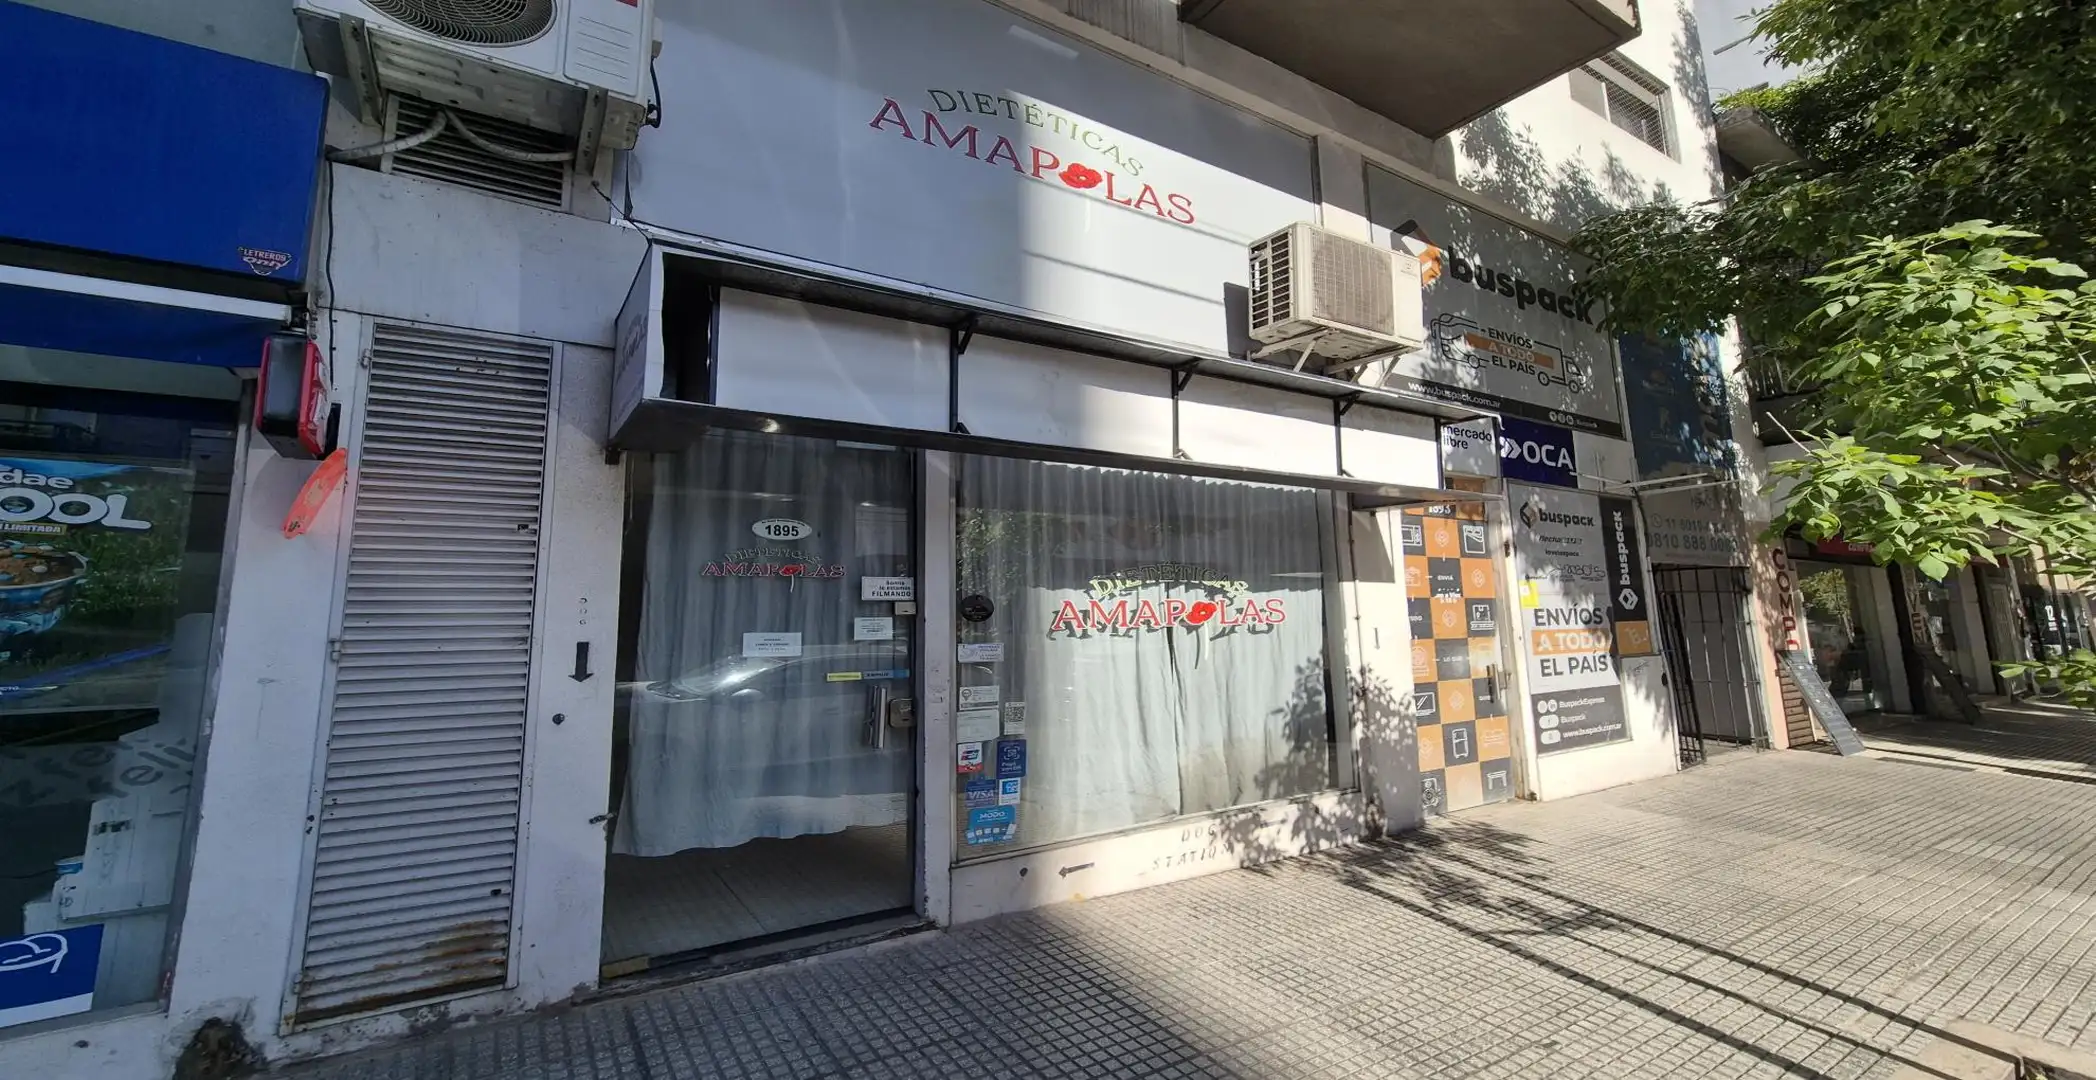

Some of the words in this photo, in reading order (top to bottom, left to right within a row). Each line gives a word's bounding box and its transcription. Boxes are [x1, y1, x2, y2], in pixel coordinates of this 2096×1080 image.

[927, 87, 1144, 177] DIETÉTICAS
[243, 248, 287, 262] LETREROS
[1447, 244, 1595, 326] buspack
[1487, 326, 1534, 350] ENVÍOS
[1488, 341, 1500, 353] A
[1501, 344, 1536, 363] TODO
[1491, 354, 1505, 369] EL
[1509, 357, 1537, 377] PAÍS
[1407, 380, 1501, 408] www.buspack.com.ar
[1443, 424, 1493, 443] mercado
[1443, 434, 1469, 450] libre
[1522, 440, 1575, 471] OCA
[4, 523, 62, 534] LIMITADA
[1539, 507, 1595, 528] buspack
[764, 524, 800, 537] 1895
[1612, 510, 1631, 585] buspack
[871, 590, 912, 598] FILMANDO
[1533, 602, 1604, 627] ENVÍOS
[1537, 633, 1553, 652] A
[1555, 630, 1607, 651] TODO
[1540, 658, 1564, 678] EL
[1568, 649, 1609, 675] PAÍS
